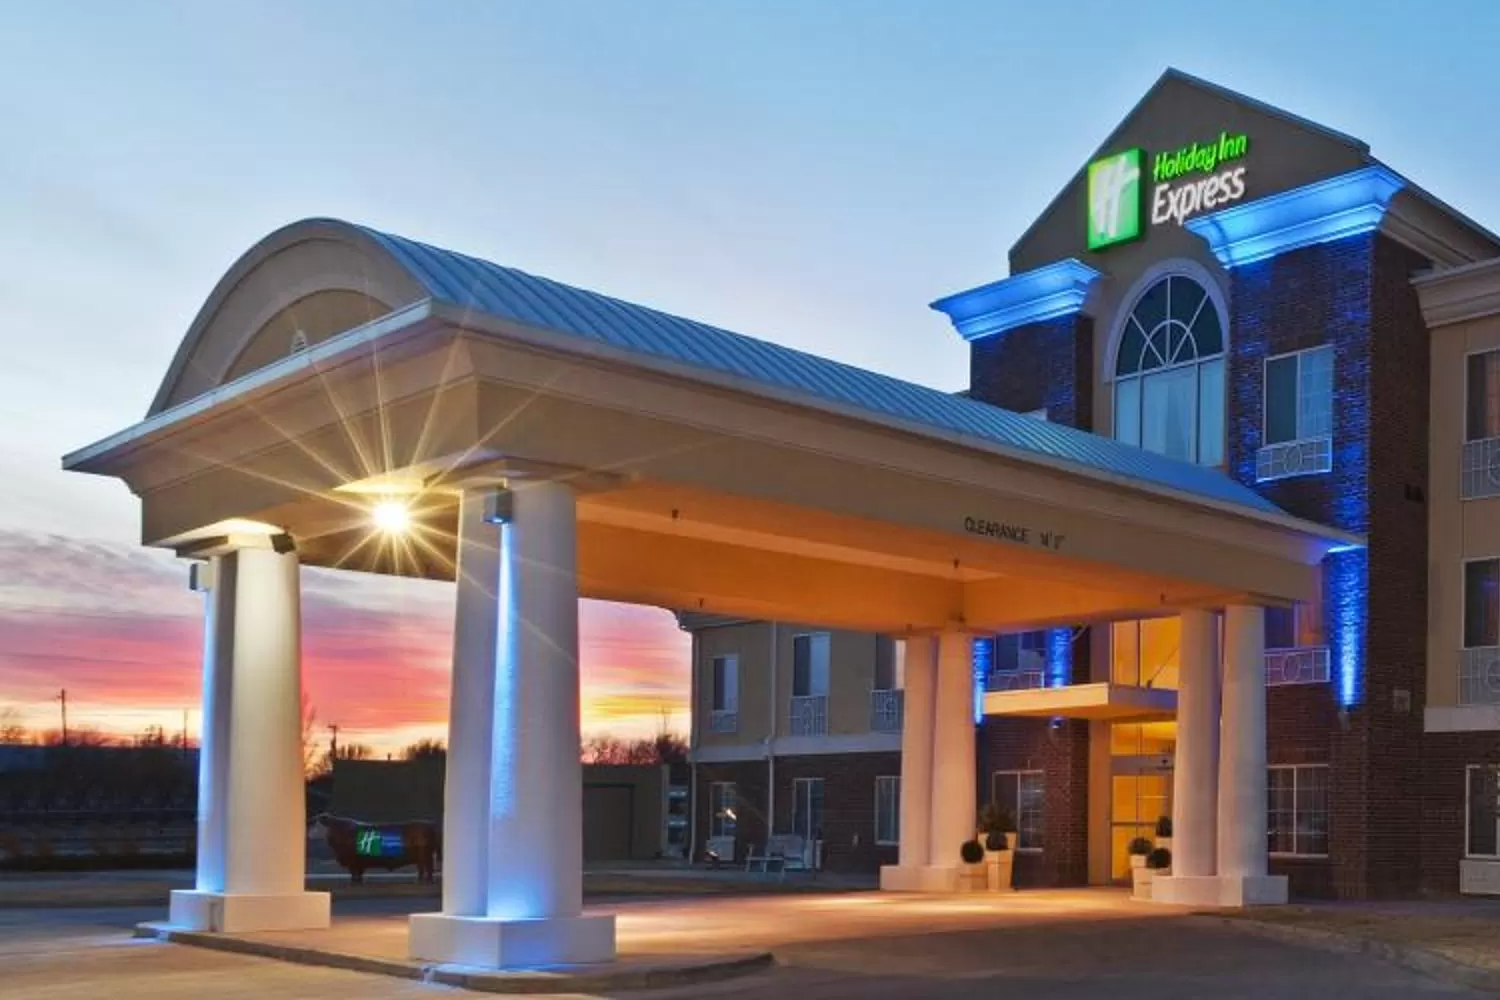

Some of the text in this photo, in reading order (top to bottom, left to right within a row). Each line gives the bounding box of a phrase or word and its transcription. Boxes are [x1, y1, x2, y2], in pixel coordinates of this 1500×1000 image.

[1153, 131, 1248, 182] Holiday Inn
[1151, 167, 1246, 226] Express
